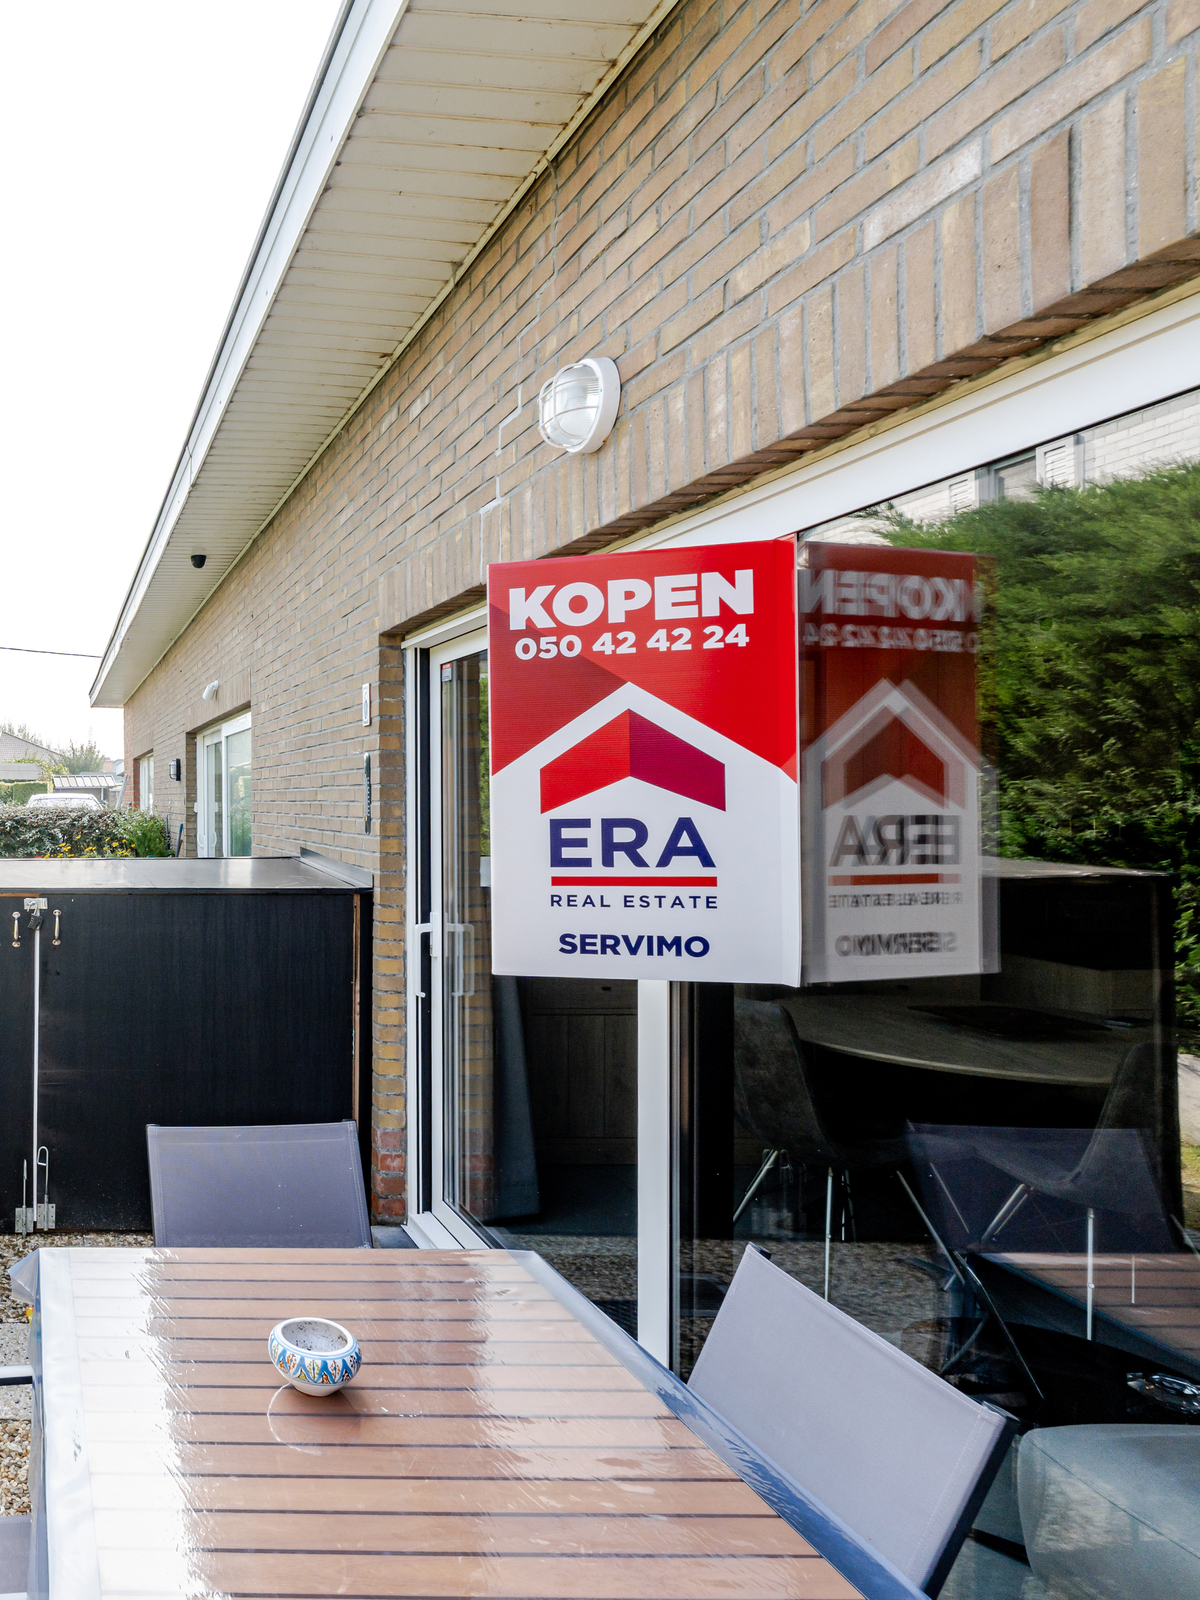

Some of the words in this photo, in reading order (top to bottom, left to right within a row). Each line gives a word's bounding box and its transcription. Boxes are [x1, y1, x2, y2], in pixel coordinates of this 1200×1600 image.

[509, 569, 754, 630] KOPEN
[514, 634, 582, 660] 050
[592, 631, 637, 655] 42
[646, 627, 692, 652] 42
[702, 623, 750, 649] 24
[549, 817, 717, 868] ERA
[550, 894, 611, 908] REAL
[623, 895, 718, 909] ESTATE
[558, 933, 710, 958] SERVIMO
